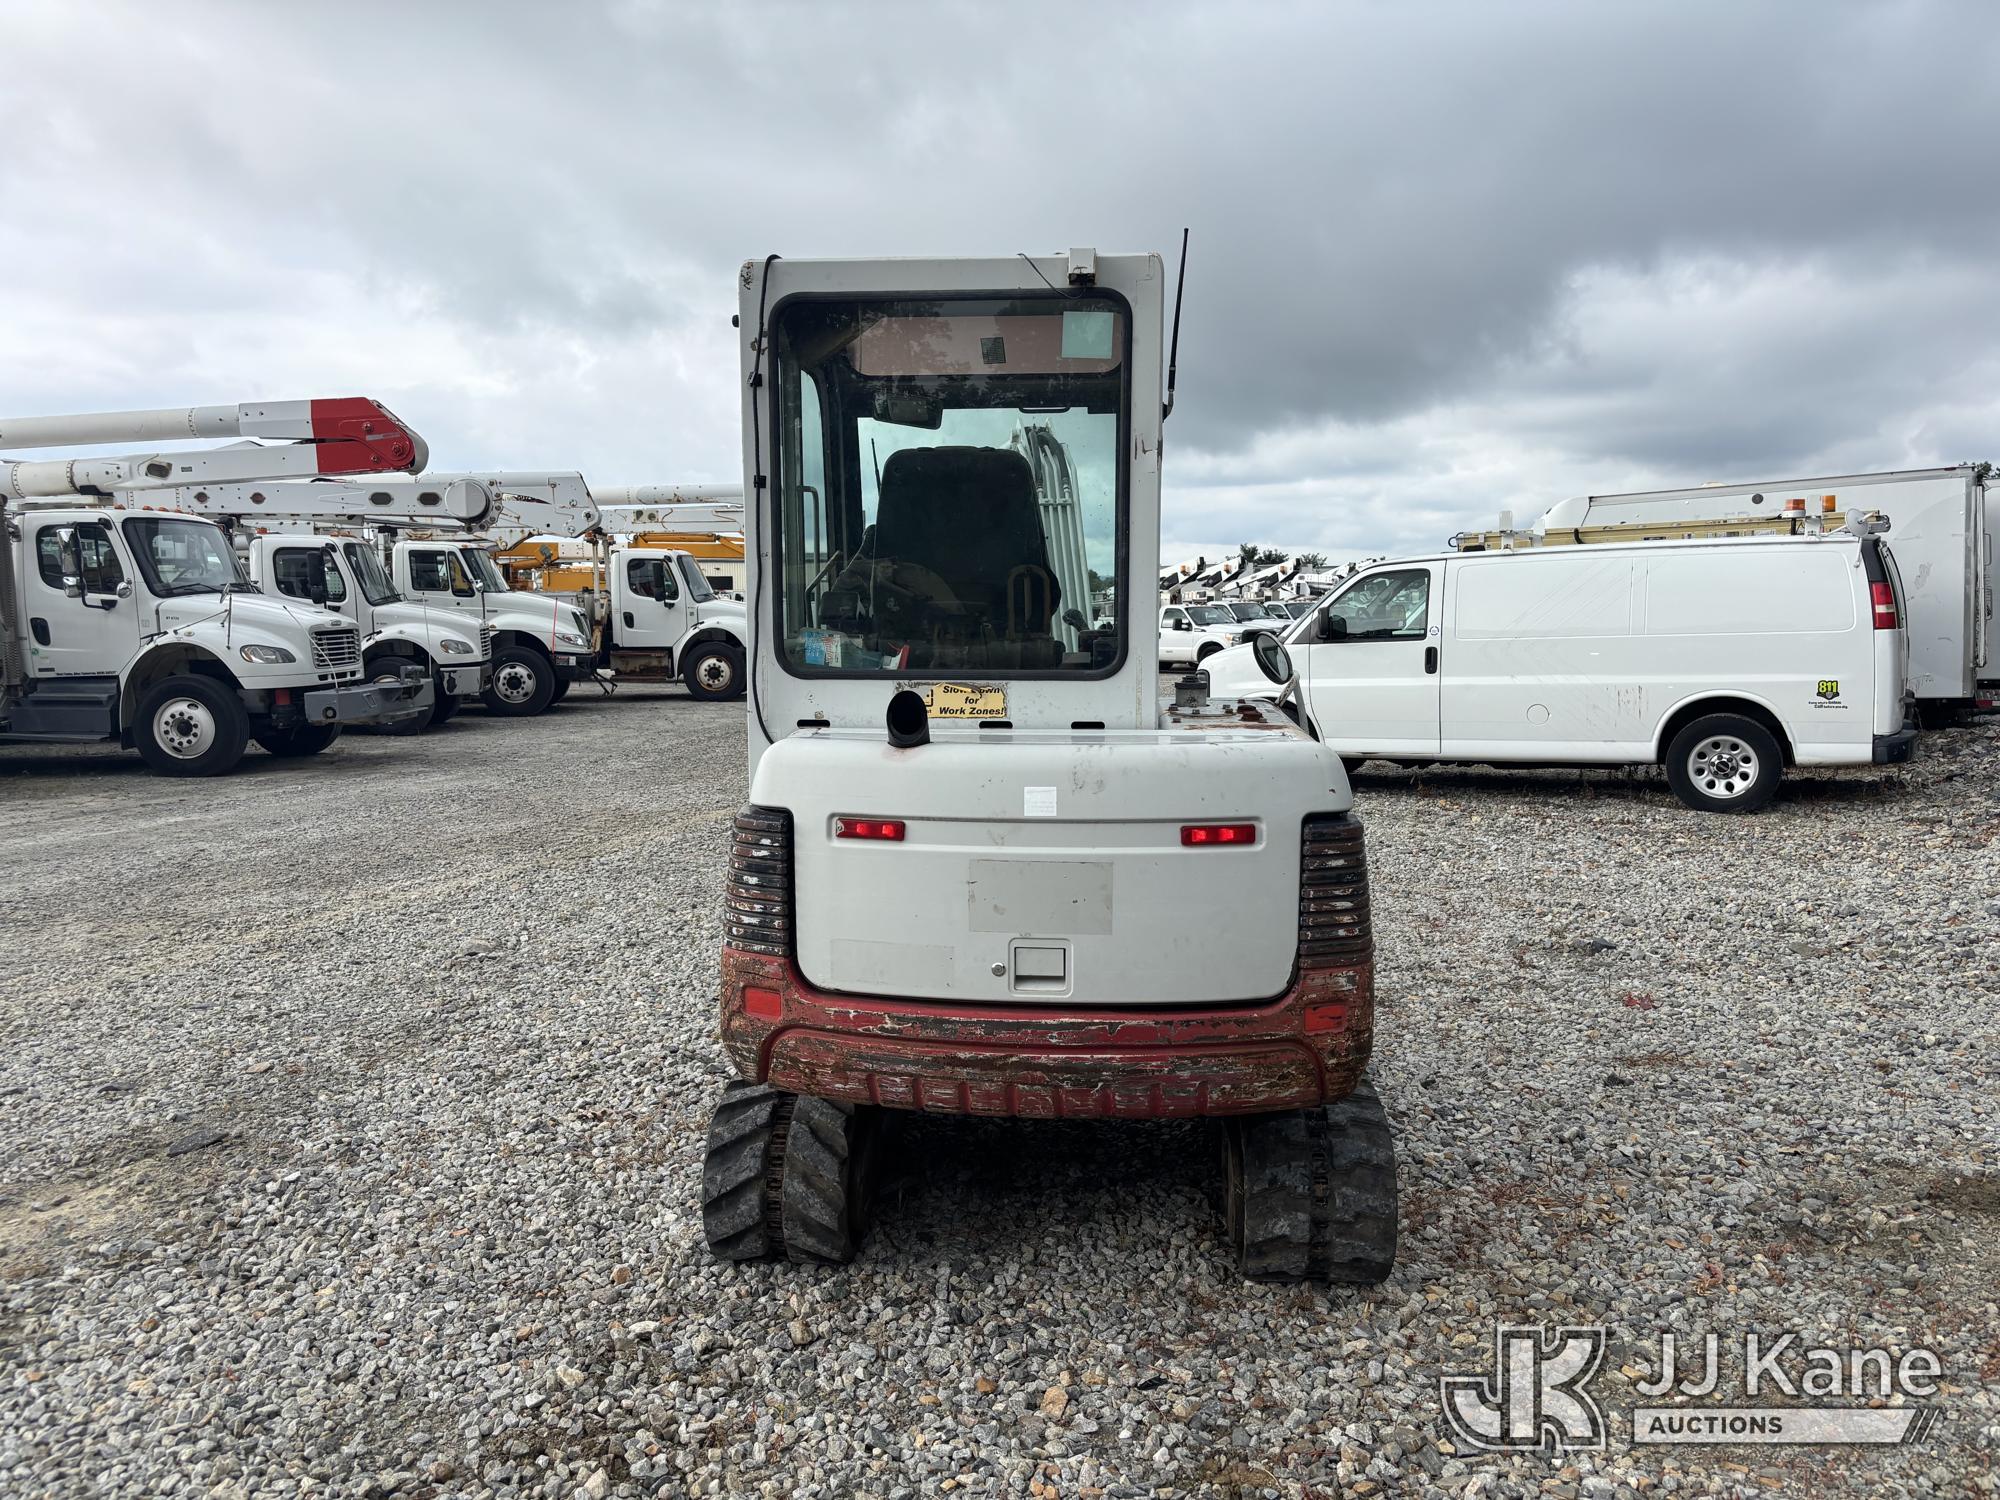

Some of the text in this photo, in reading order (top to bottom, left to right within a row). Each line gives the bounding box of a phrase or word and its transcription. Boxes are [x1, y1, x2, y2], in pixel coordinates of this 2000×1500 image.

[1819, 681, 1837, 693] 811
[964, 695, 980, 705] for
[939, 706, 966, 715] Work
[968, 706, 1005, 715] Zones!
